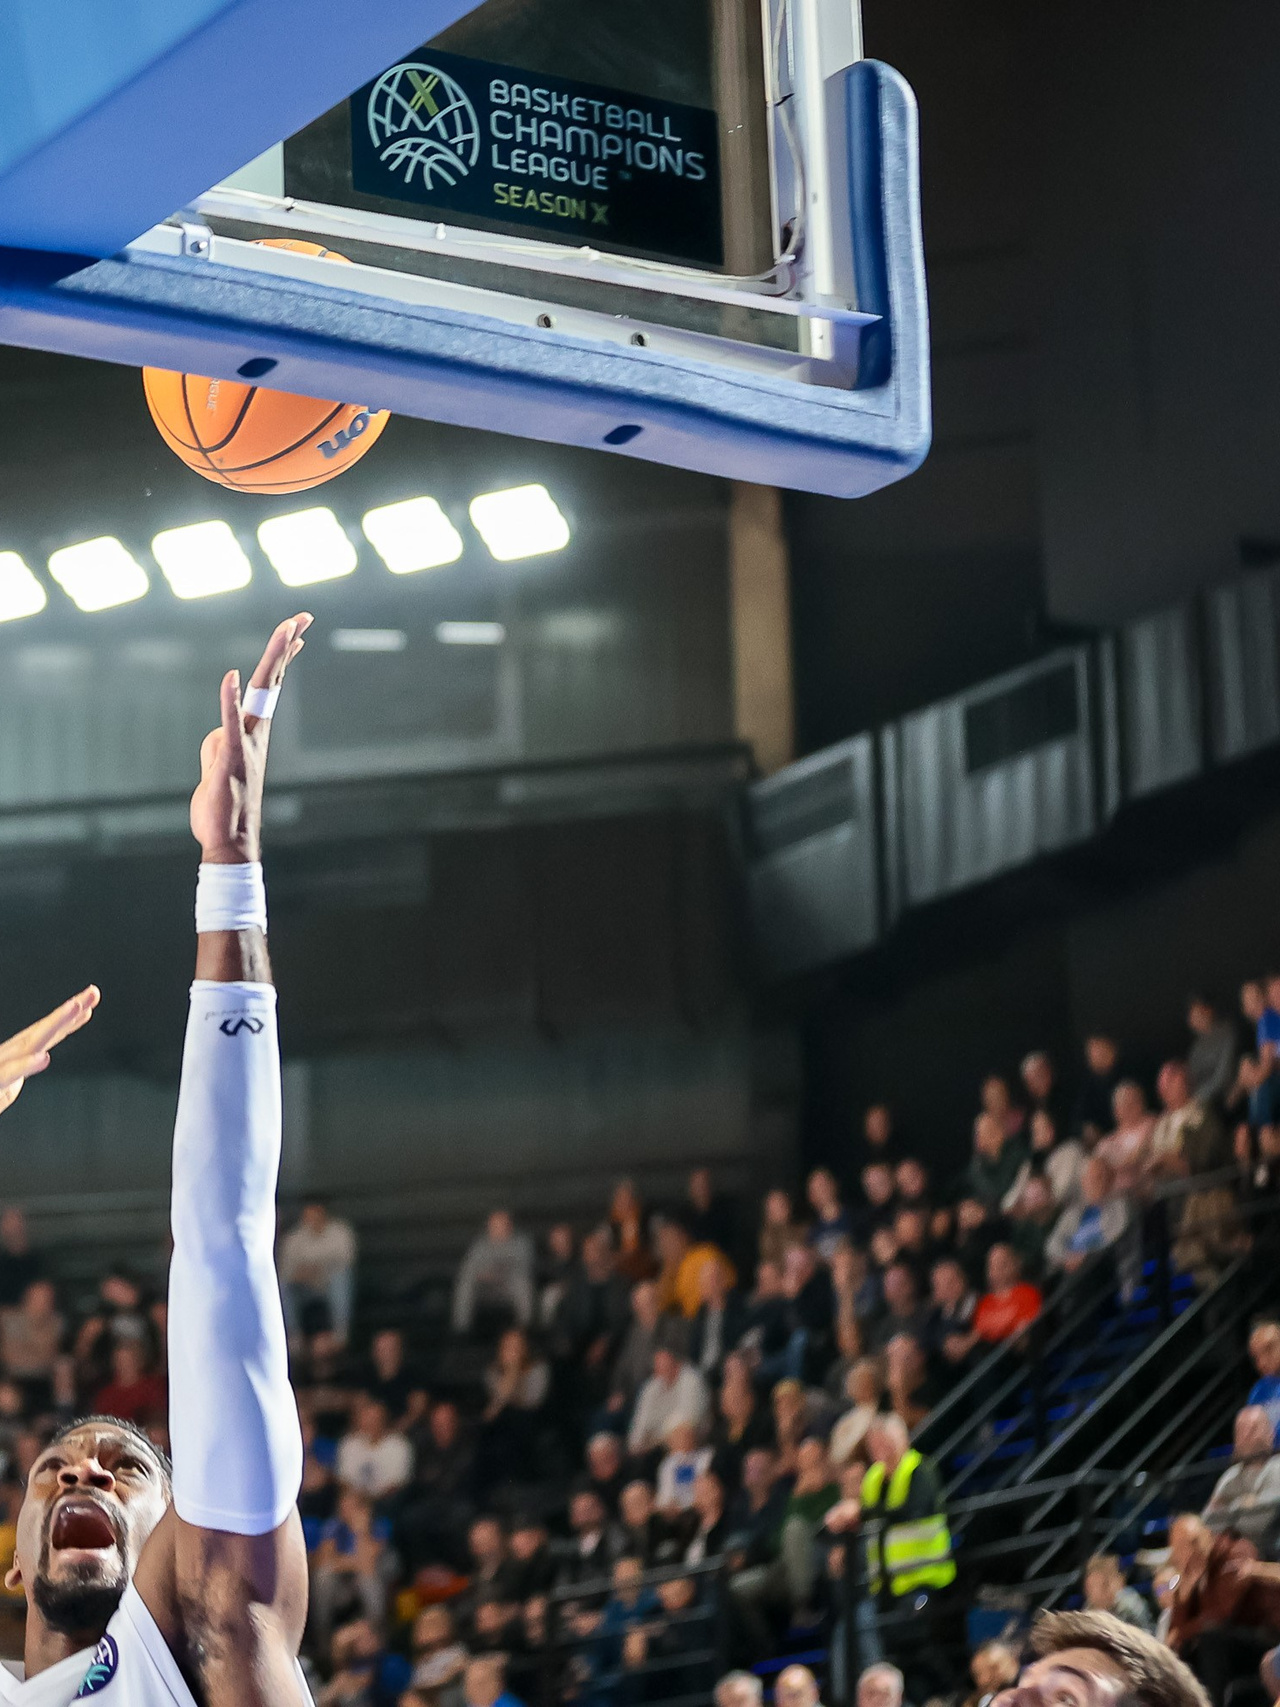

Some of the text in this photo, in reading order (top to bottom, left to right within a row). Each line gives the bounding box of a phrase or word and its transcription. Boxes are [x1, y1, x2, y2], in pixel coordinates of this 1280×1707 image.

[489, 79, 682, 142] BASKETBALL
[490, 110, 707, 181] CHAMPIONS
[491, 144, 608, 190] LEAGUE
[494, 182, 609, 226] SEASON X
